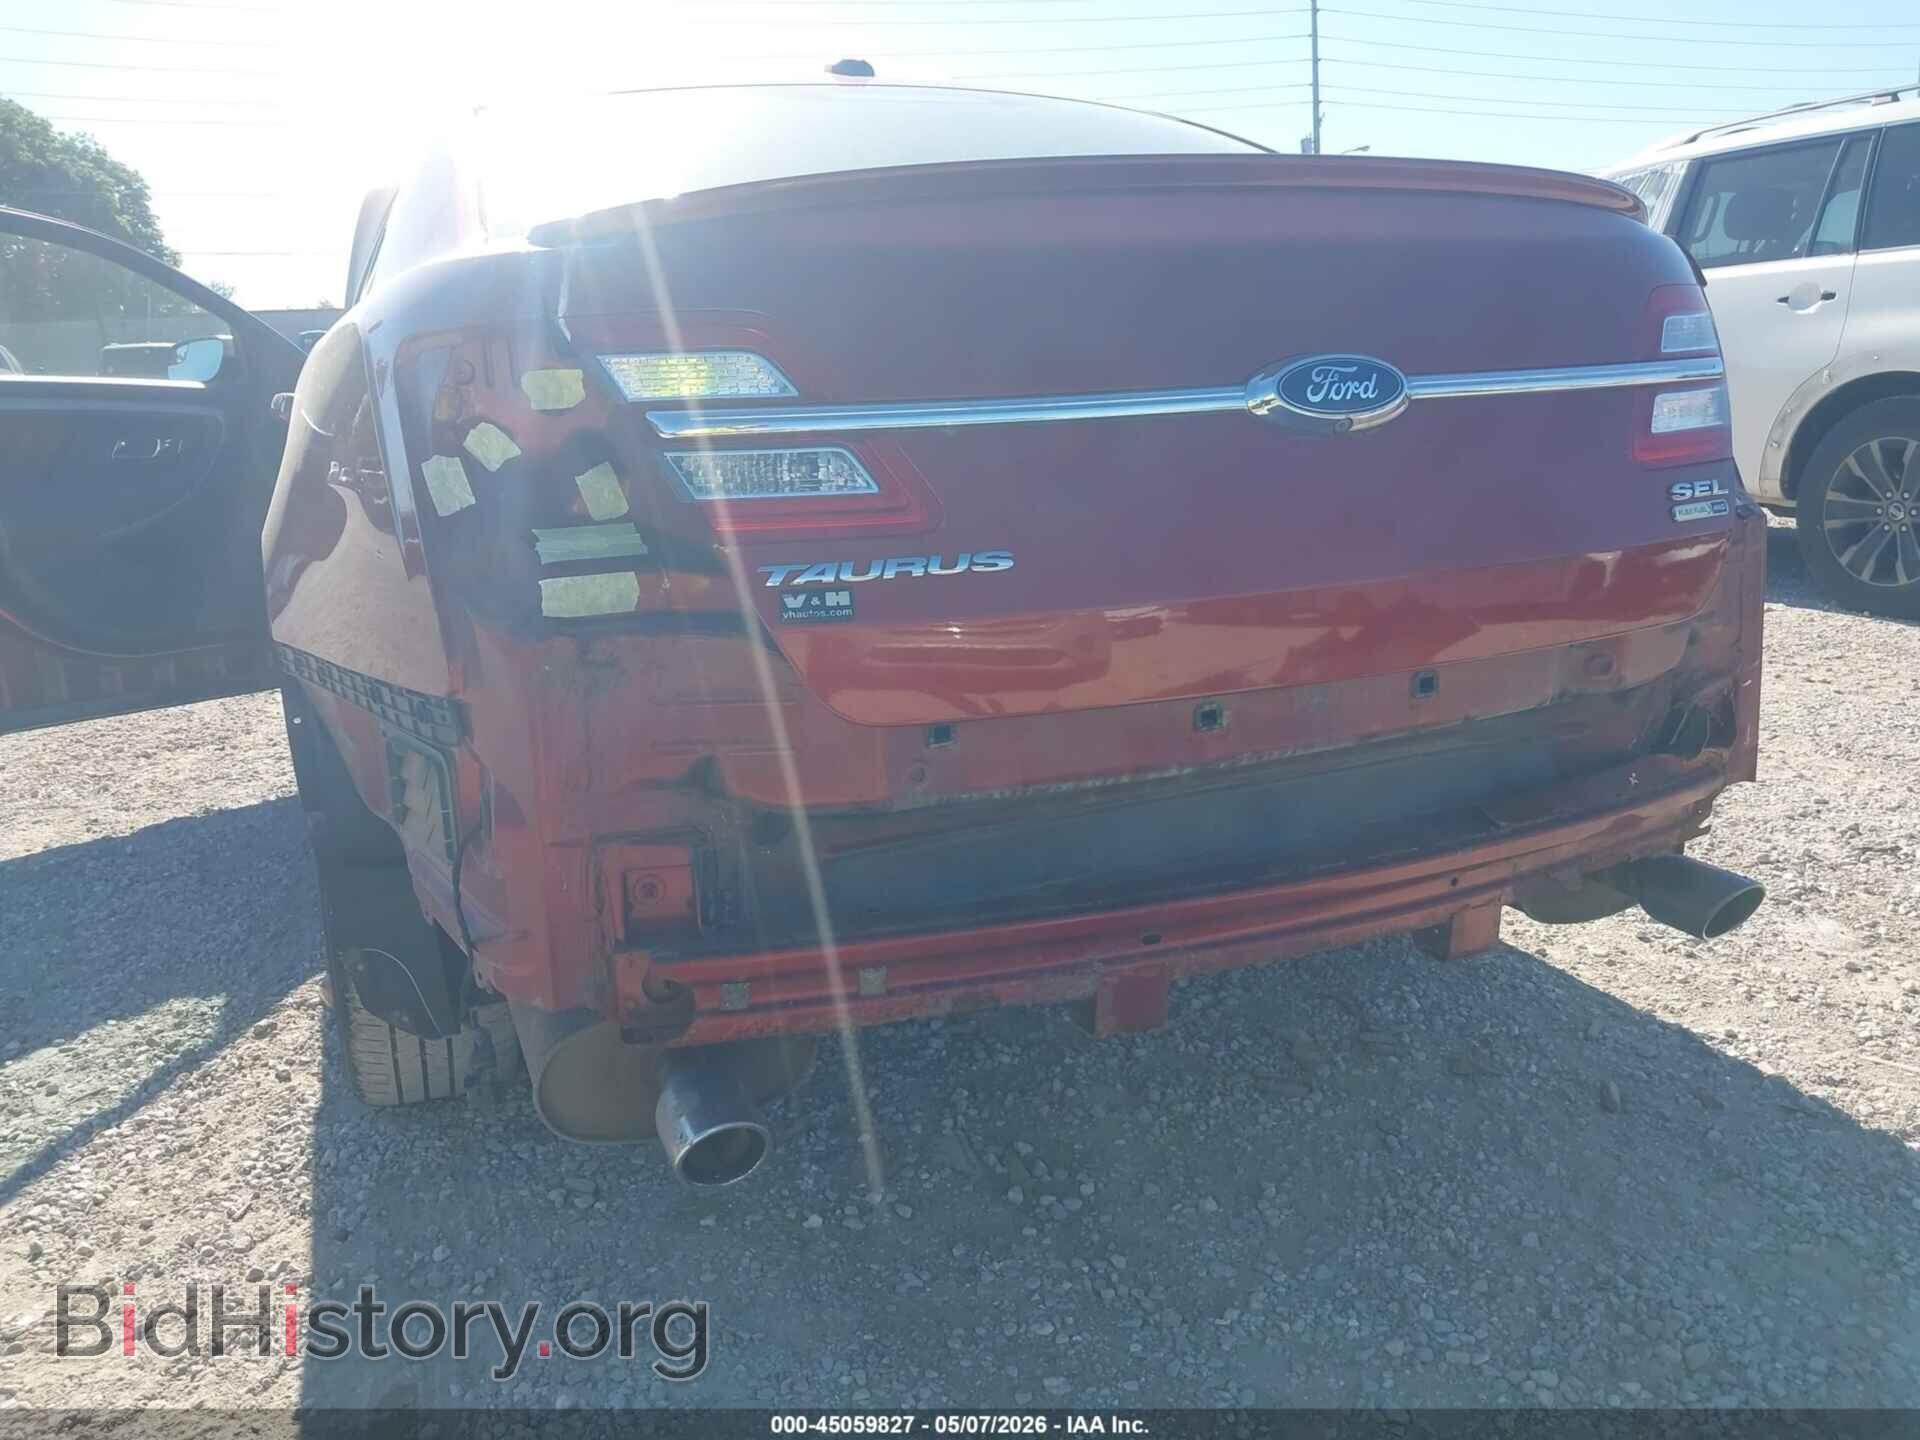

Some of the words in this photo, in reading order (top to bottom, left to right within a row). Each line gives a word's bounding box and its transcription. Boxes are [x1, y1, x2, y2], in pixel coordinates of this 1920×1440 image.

[1306, 366, 1378, 402] Ford
[1671, 480, 1728, 500] SEL
[757, 550, 1014, 586] TAURUS
[811, 596, 820, 606] &
[825, 591, 851, 606] H
